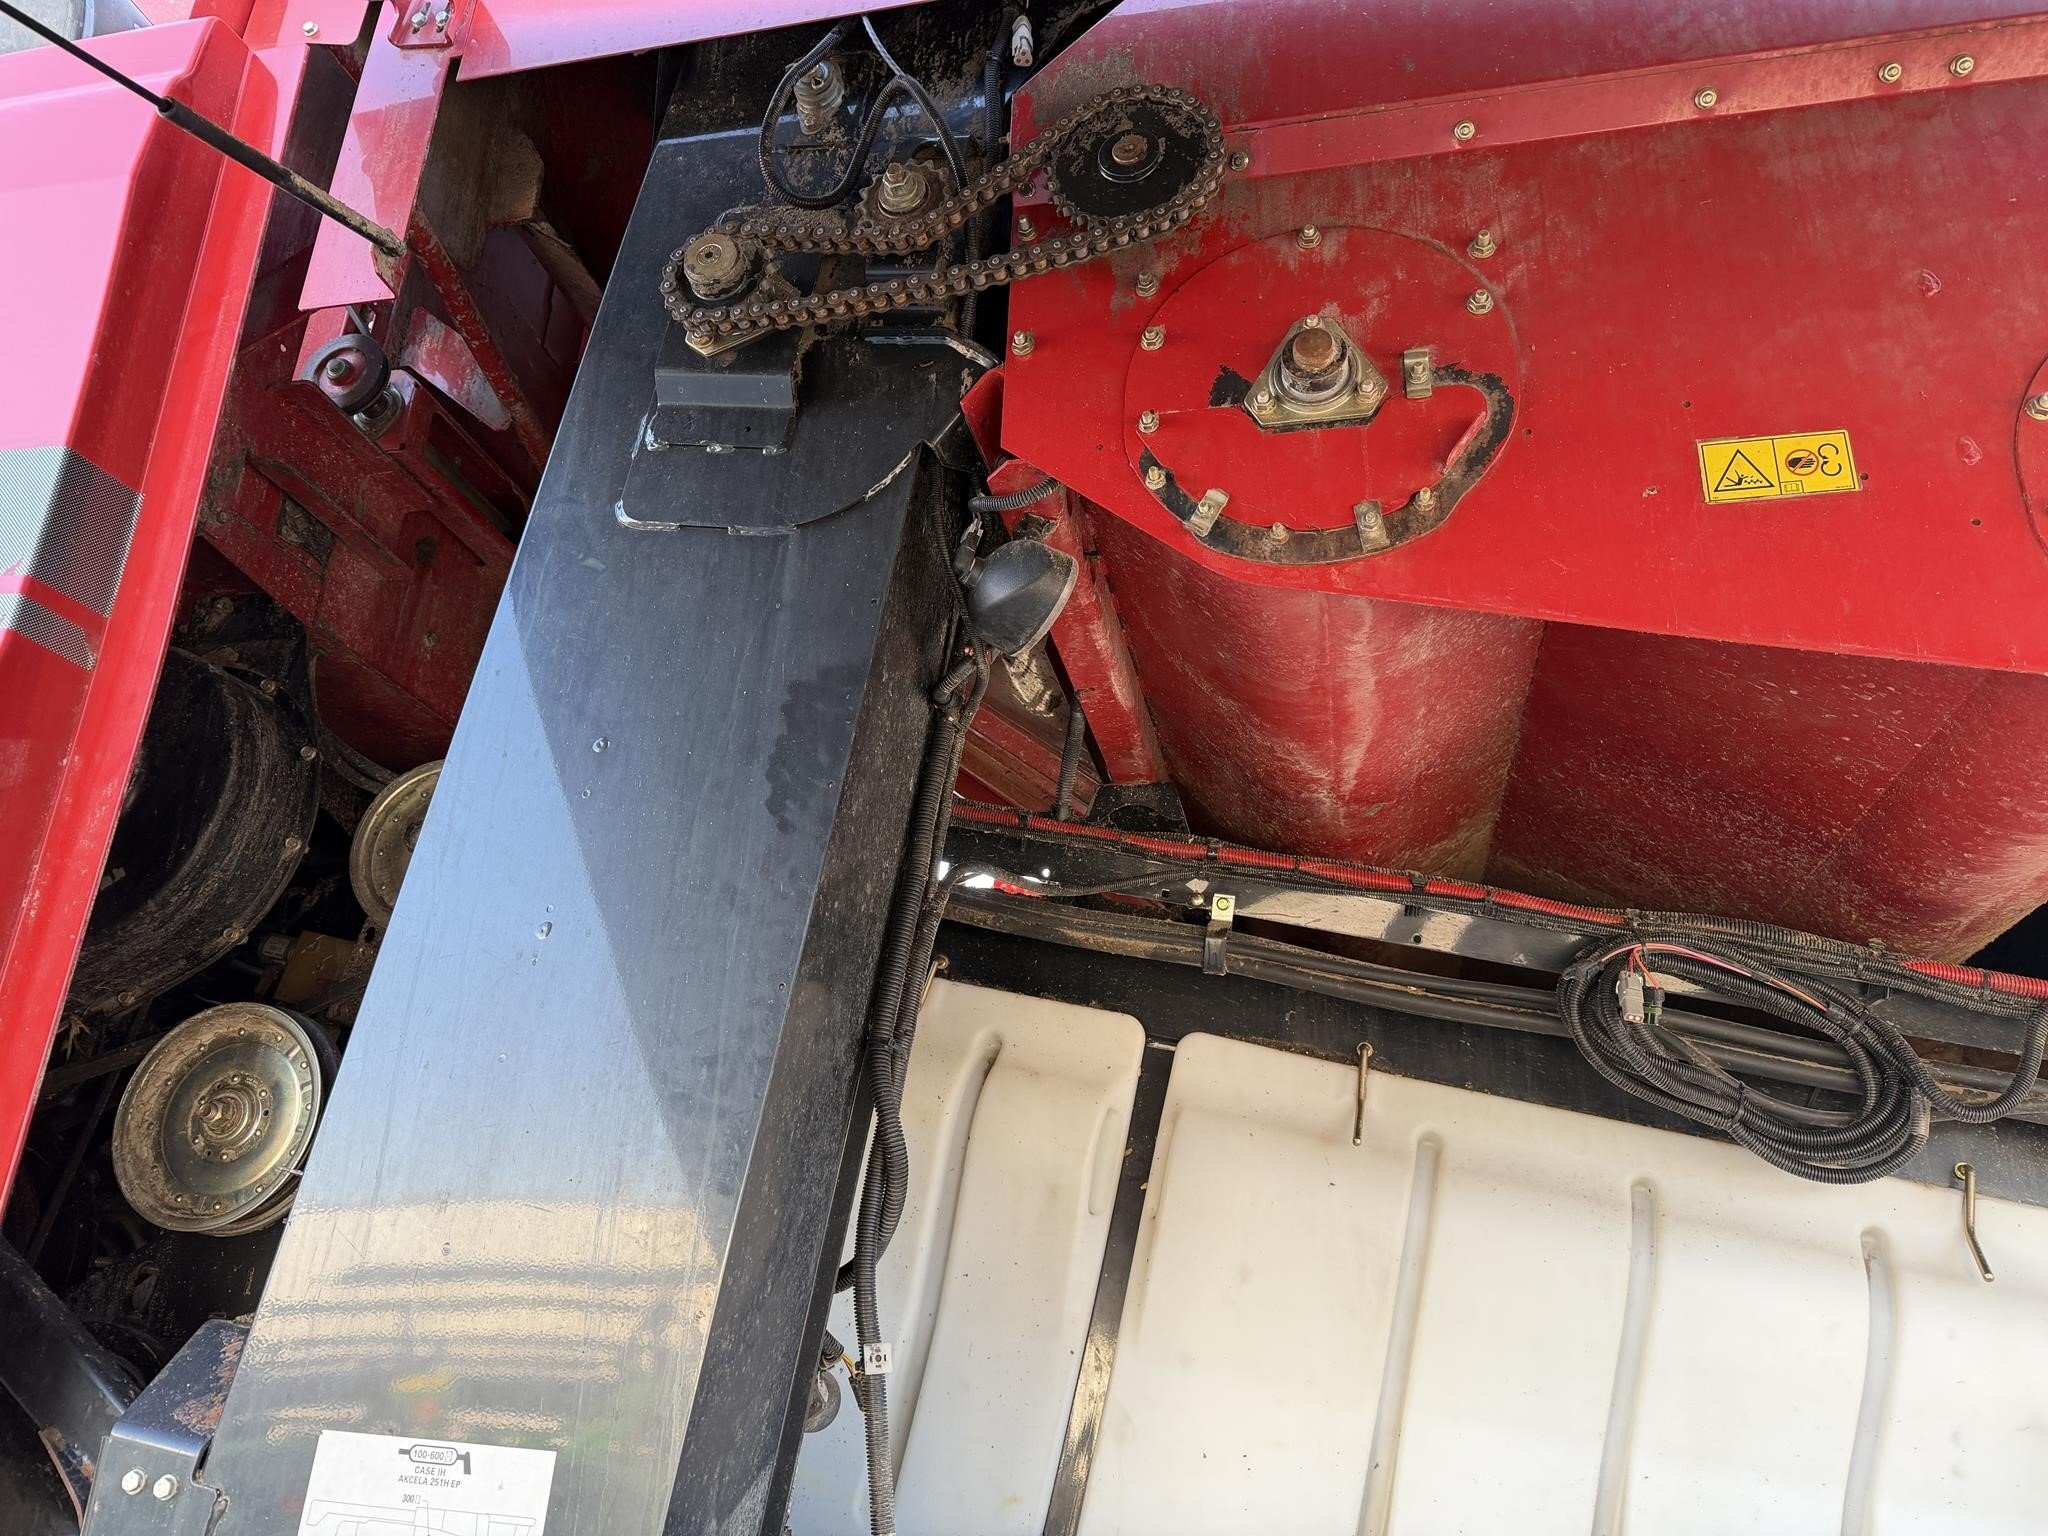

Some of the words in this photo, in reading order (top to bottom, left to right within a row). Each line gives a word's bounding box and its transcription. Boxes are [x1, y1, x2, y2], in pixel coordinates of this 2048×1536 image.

[414, 1466, 437, 1476] CASE
[438, 1467, 447, 1477] IH
[398, 1475, 428, 1486] AKCELA
[429, 1477, 450, 1488] 251H
[450, 1479, 461, 1489] EP
